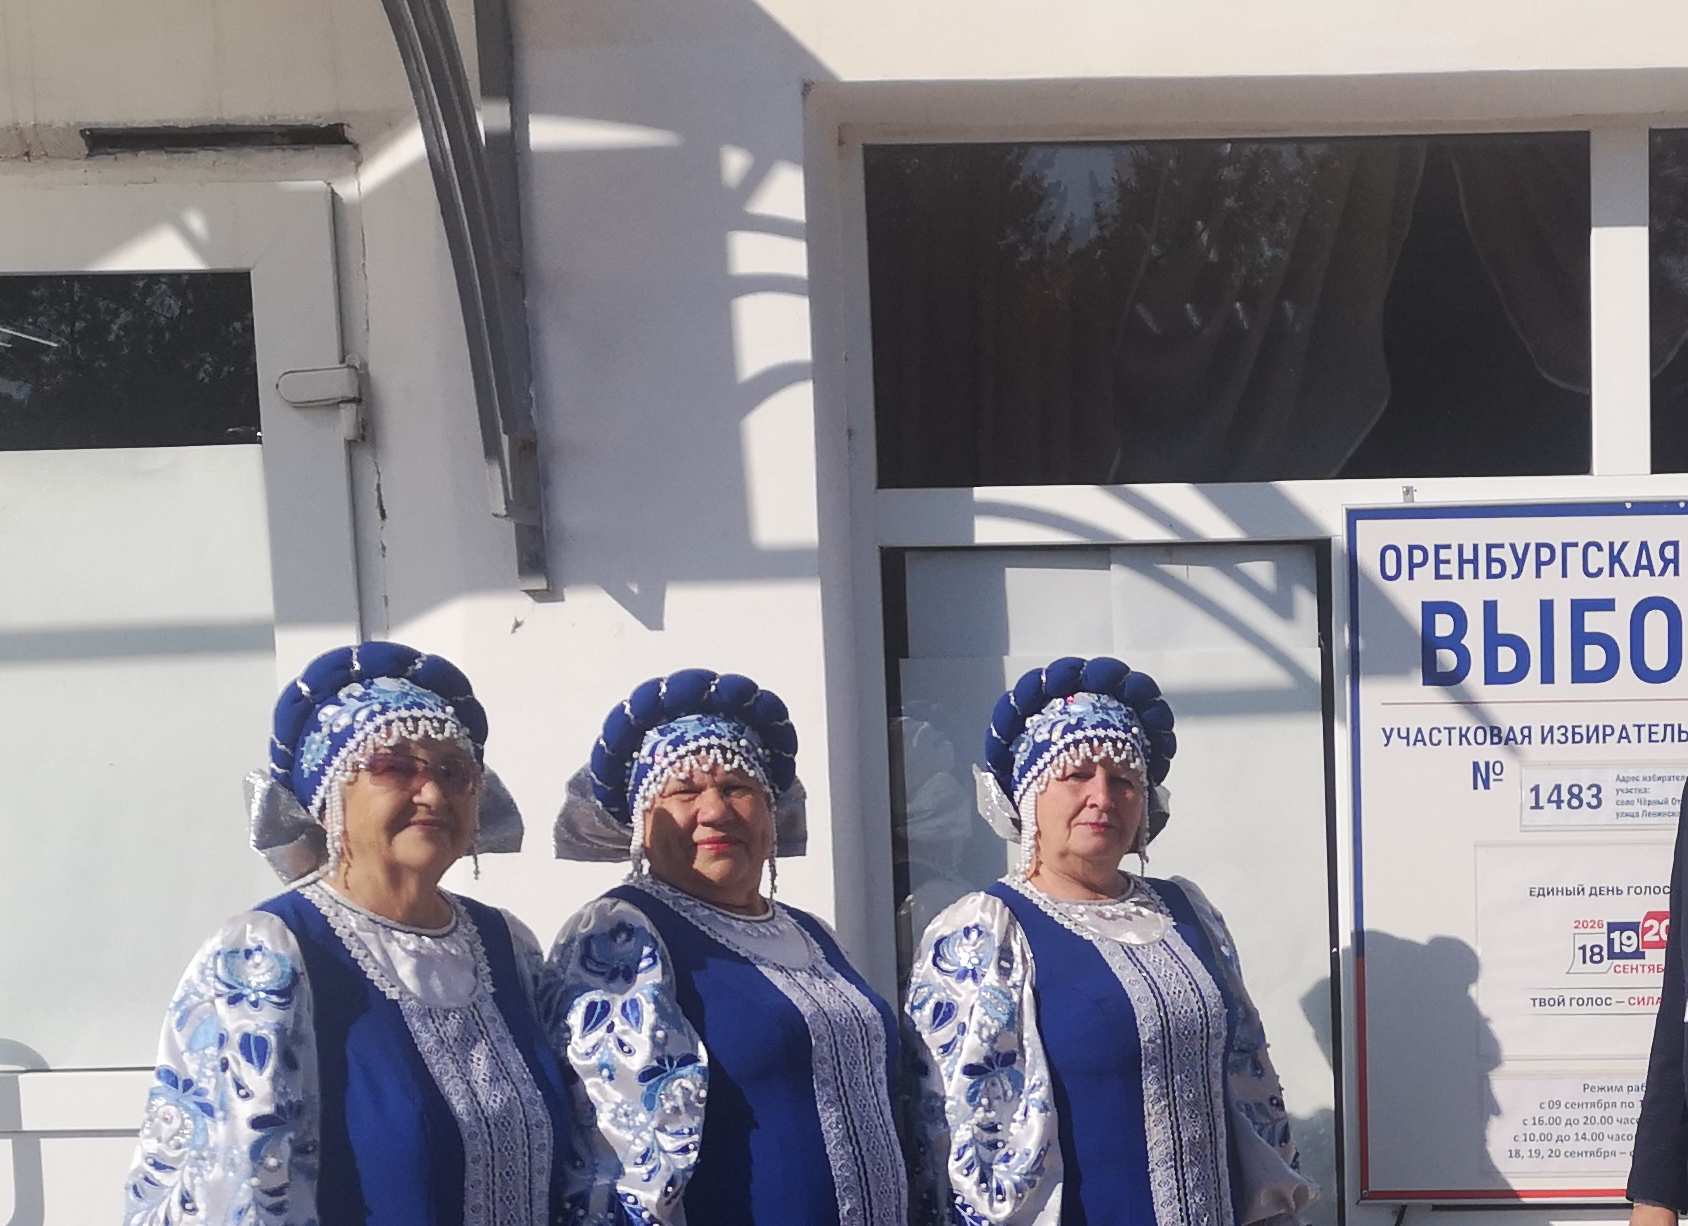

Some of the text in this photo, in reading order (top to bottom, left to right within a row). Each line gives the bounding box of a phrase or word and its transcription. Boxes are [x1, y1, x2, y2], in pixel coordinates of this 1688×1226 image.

[1379, 540, 1680, 582] ОРЕНБУРГСКАЯ
[1381, 725, 1532, 747] УЧАСТКОВАЯ
[1472, 760, 1504, 790] №
[1615, 773, 1687, 783] Адрес избирател
[1529, 783, 1603, 810] 1483
[1615, 787, 1650, 796] участка:
[1615, 811, 1640, 819] улица
[1529, 884, 1671, 898] ЕДИНЫЙ ДЕНЬ ГОЛОС
[1573, 919, 1604, 930] 2026
[1577, 943, 1604, 965] 18
[1609, 930, 1639, 953] 19
[1613, 964, 1665, 974] СЕНТЯБ
[1531, 995, 1565, 1007] ТВОЙ
[1569, 997, 1612, 1007] ГОЛОС
[1583, 1082, 1647, 1094] Режим раб
[1547, 1100, 1562, 1110] 09
[1564, 1099, 1617, 1111] сентября
[1620, 1101, 1635, 1109] по
[1522, 1118, 1528, 1126] с
[1532, 1116, 1562, 1126] 16.00
[1564, 1117, 1580, 1127] до
[1583, 1116, 1614, 1126] 20.00
[1513, 1132, 1634, 1143] с 10.00 до 14.00 часо
[1508, 1148, 1525, 1160] 18,
[1528, 1148, 1544, 1160] 19,
[1547, 1148, 1562, 1158] 20
[1564, 1148, 1617, 1160] сентября
